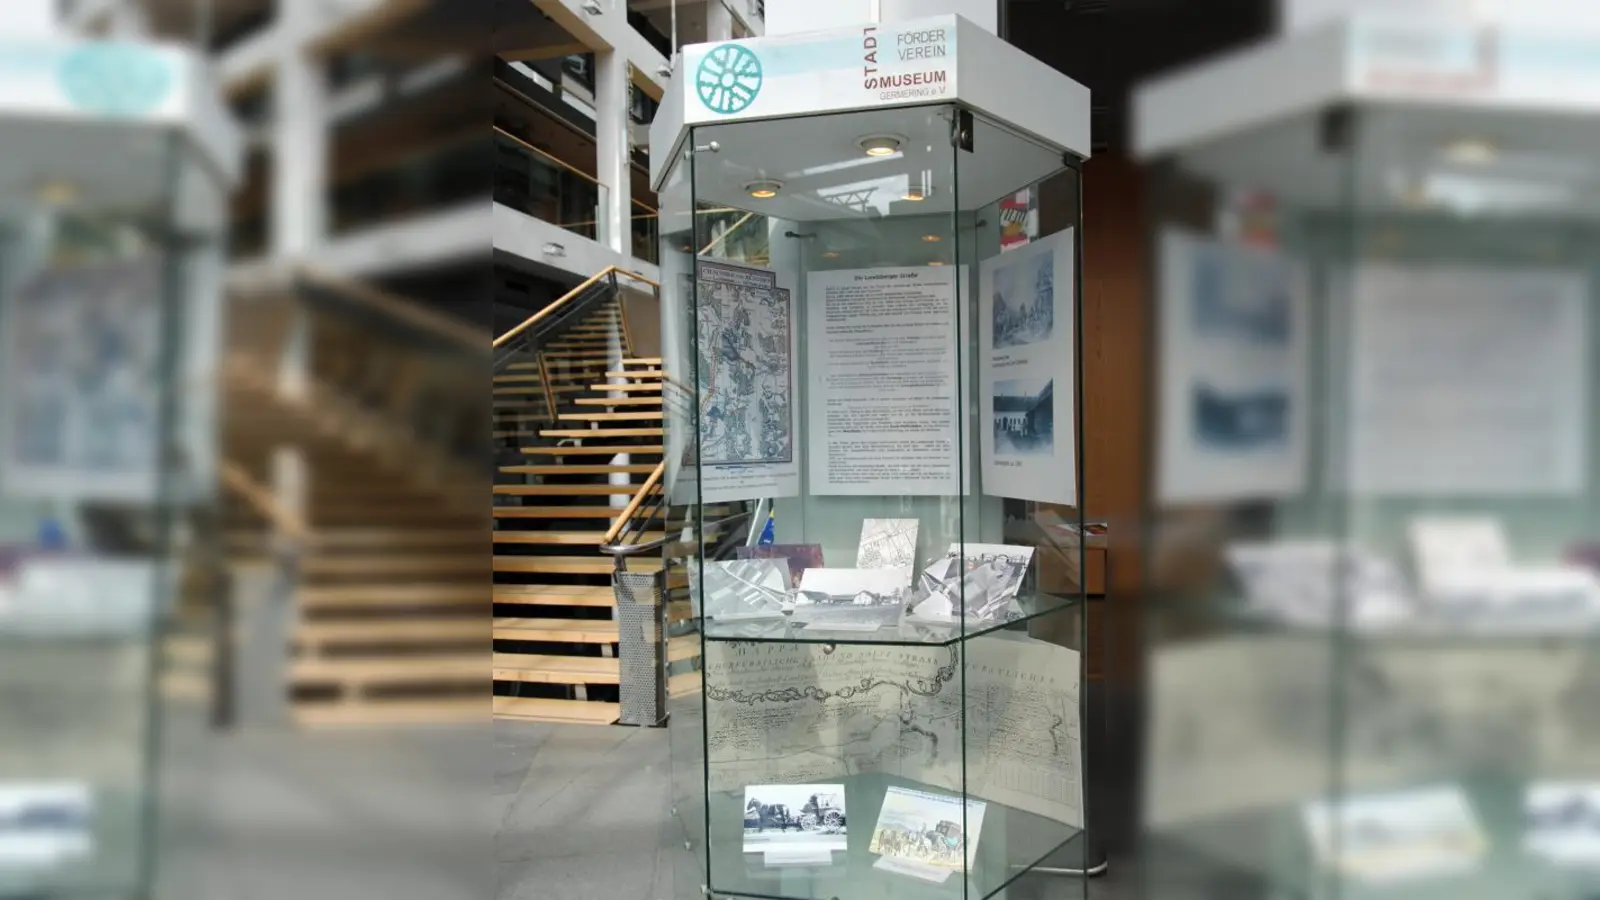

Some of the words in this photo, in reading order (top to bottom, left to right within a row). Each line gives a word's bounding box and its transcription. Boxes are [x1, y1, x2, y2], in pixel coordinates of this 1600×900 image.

[897, 29, 945, 45] FÖRDER
[864, 27, 878, 89] STADT
[898, 45, 946, 61] VEREIN
[880, 70, 946, 88] MUSEUM
[880, 88, 929, 100] GERMERING
